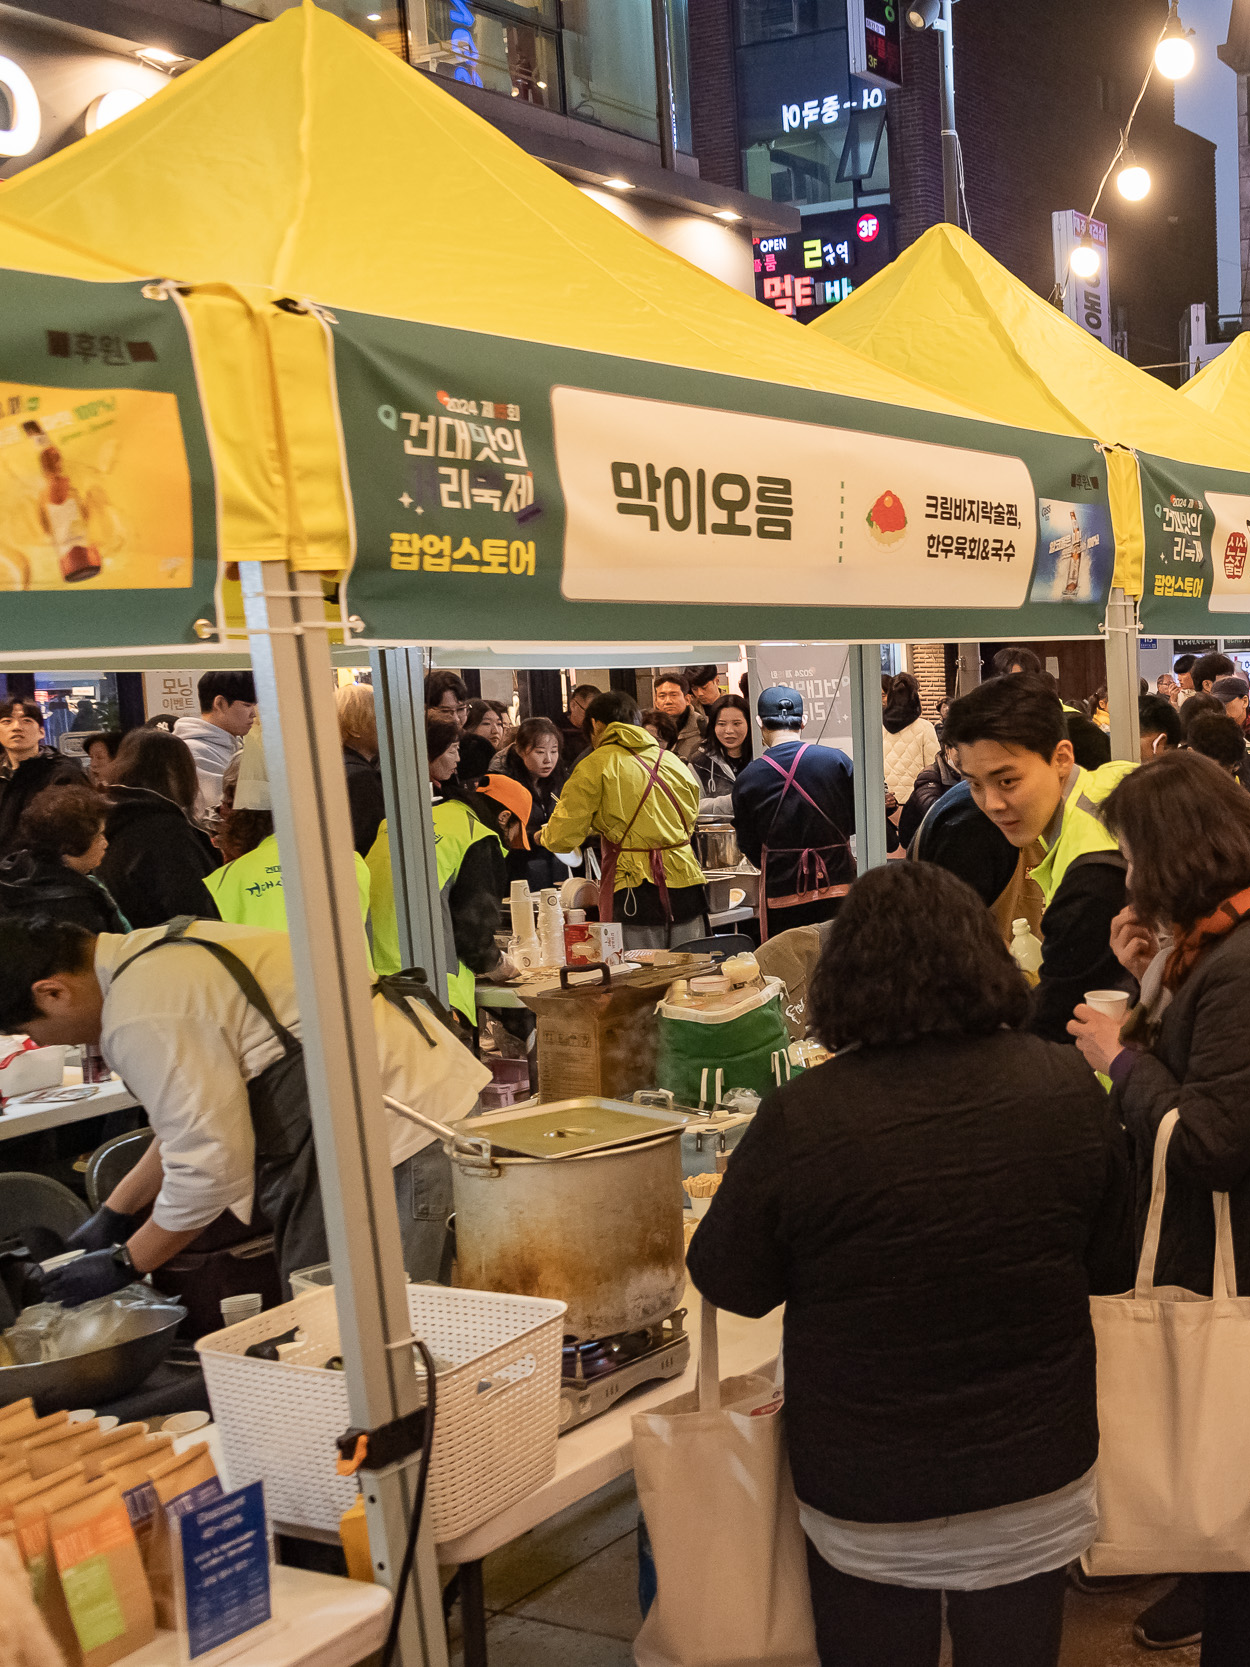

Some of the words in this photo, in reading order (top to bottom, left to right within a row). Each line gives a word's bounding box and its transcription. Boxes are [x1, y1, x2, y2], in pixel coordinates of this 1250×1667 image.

[858, 219, 879, 238] 3F
[760, 237, 787, 253] OPEN
[401, 412, 529, 468] 건대맛의
[611, 461, 794, 541] 막이오름
[924, 494, 1022, 530] 크림바지락술찜,
[1162, 507, 1203, 537] 건대맛의
[389, 532, 537, 576] 팝업스토어
[926, 533, 1016, 563] 한우육회&국수
[1153, 574, 1205, 599] 팝업스토어
[161, 676, 194, 697] 모닝
[162, 697, 195, 711] 이벤트
